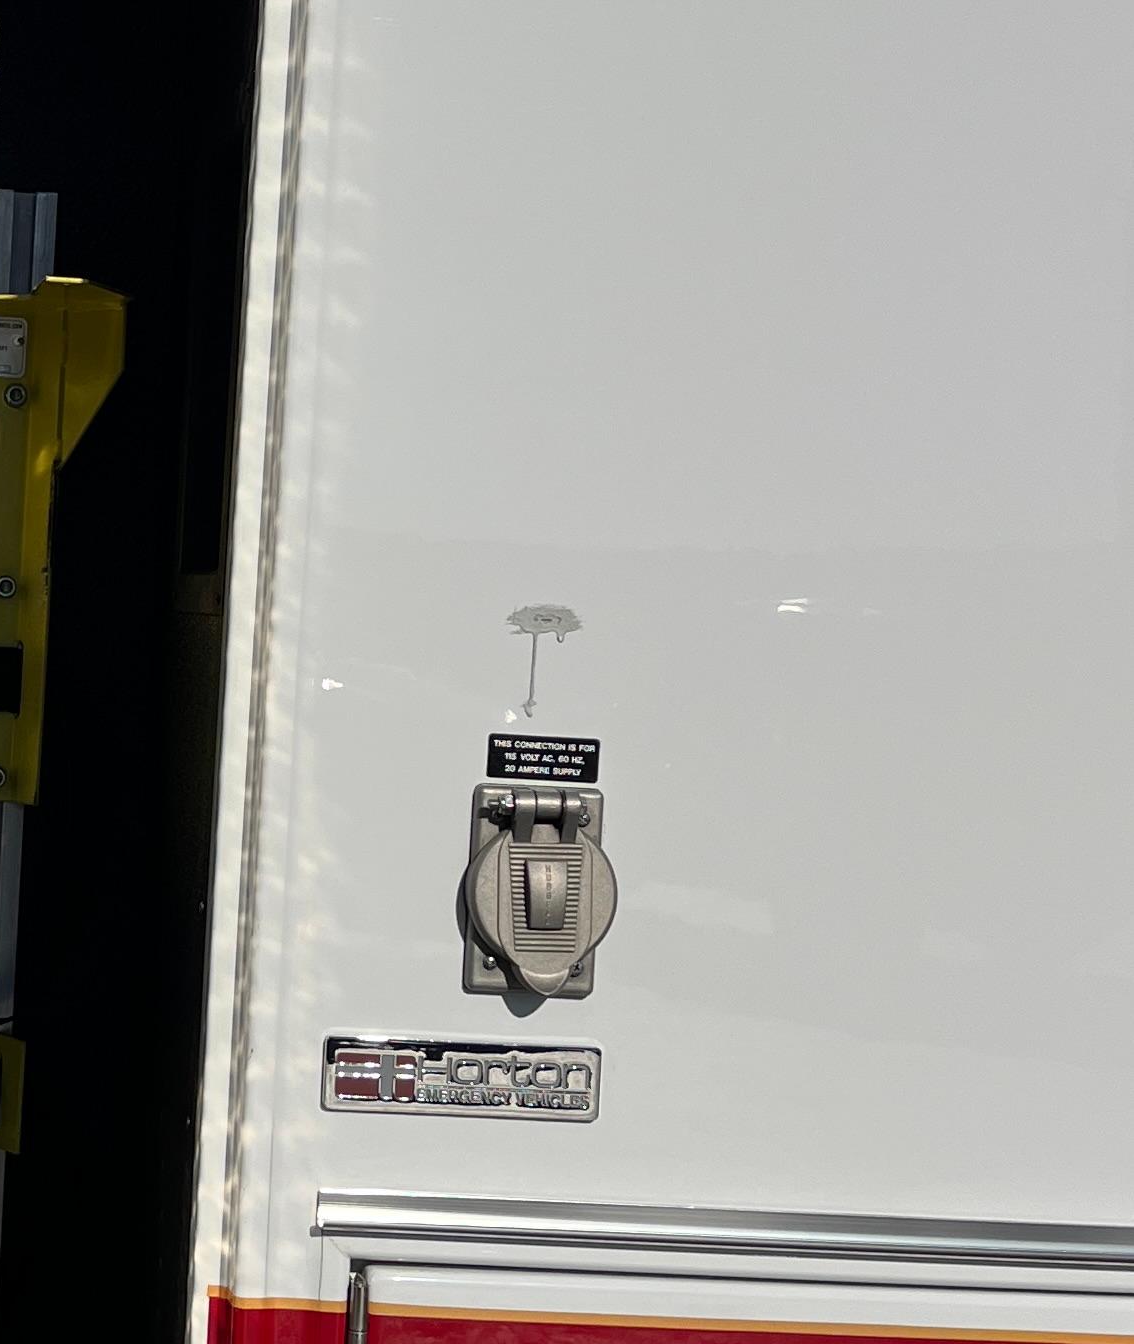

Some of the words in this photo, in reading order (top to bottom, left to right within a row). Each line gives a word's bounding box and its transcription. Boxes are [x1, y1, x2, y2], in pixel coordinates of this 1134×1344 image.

[493, 739, 512, 748] THIS
[514, 740, 566, 751] CONNECTION
[567, 743, 577, 752] IS
[578, 744, 596, 753] FOR
[520, 752, 540, 762] VOLT
[558, 755, 570, 763] 60
[504, 764, 516, 773] 20
[517, 765, 550, 775] AMPERE
[552, 767, 582, 776] SUPPLY
[416, 1055, 593, 1091] Horton
[416, 1087, 512, 1106] EMERGENCY
[516, 1090, 590, 1110] VEHICLES
